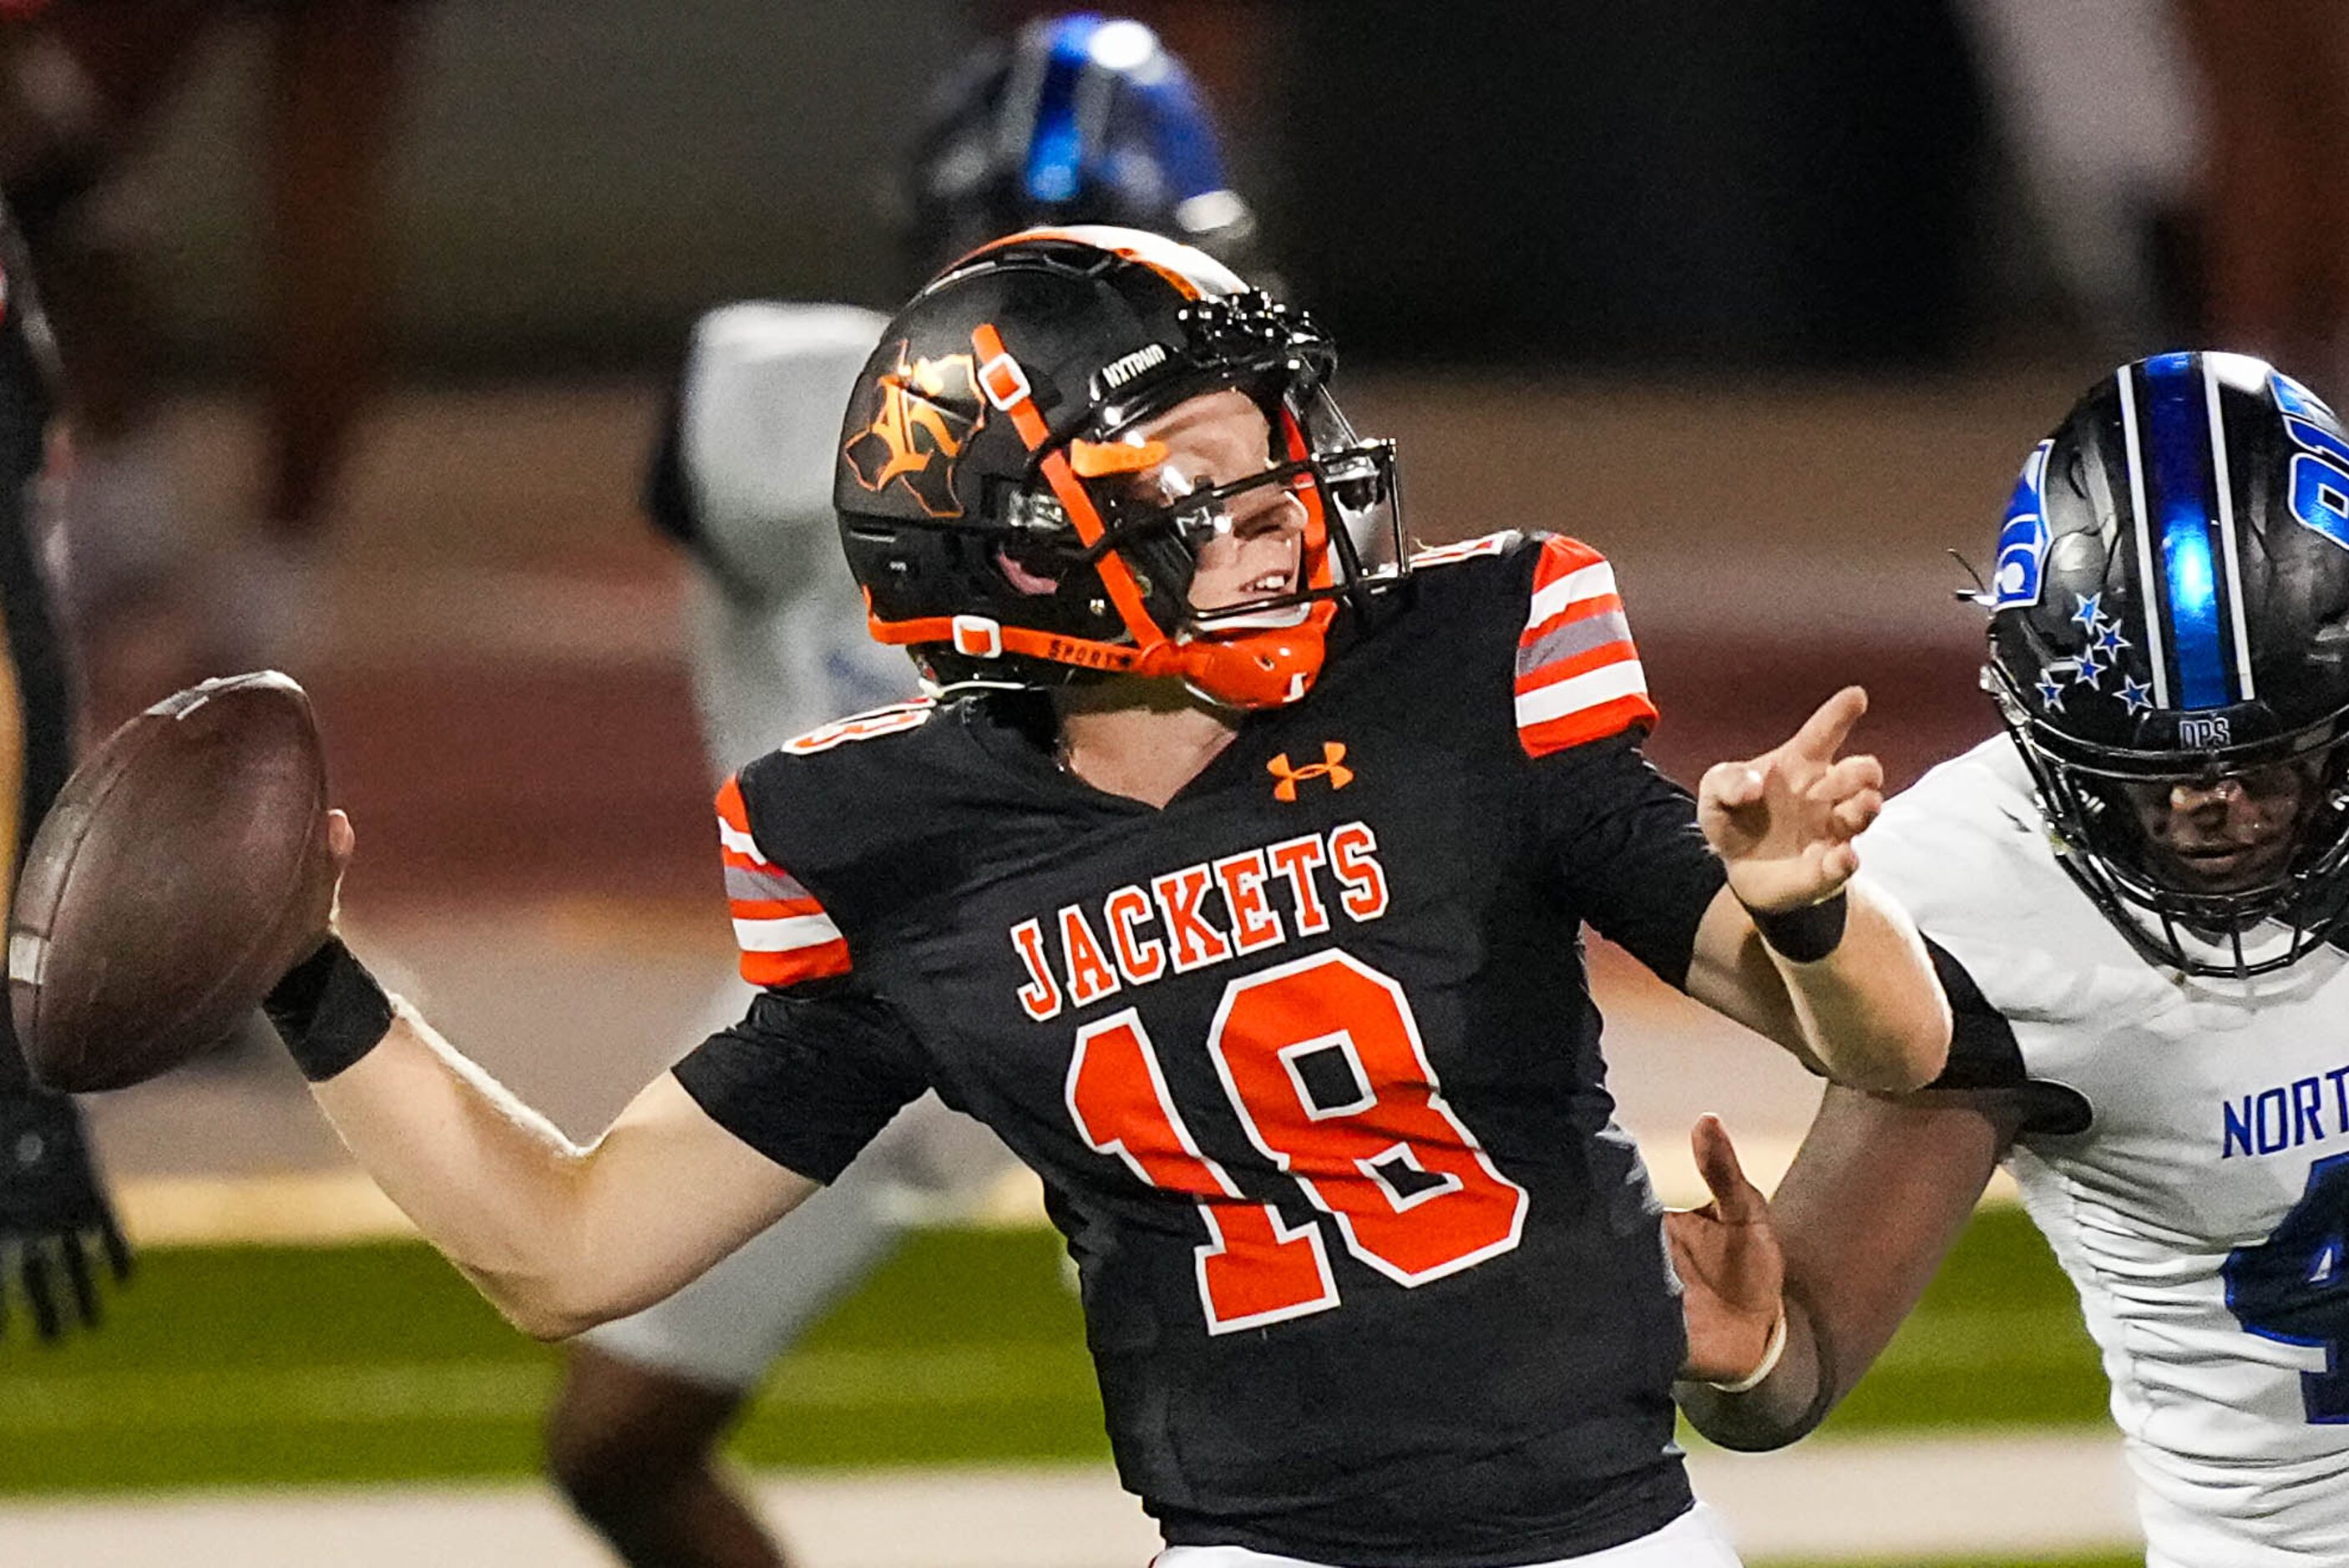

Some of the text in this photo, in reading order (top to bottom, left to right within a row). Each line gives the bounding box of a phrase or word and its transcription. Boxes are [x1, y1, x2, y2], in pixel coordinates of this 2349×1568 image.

[1048, 639, 1116, 666] SPORT
[1011, 821, 1390, 1022] JACKETS
[1066, 948, 1529, 1336] 18
[2222, 1065, 2349, 1159] NORT
